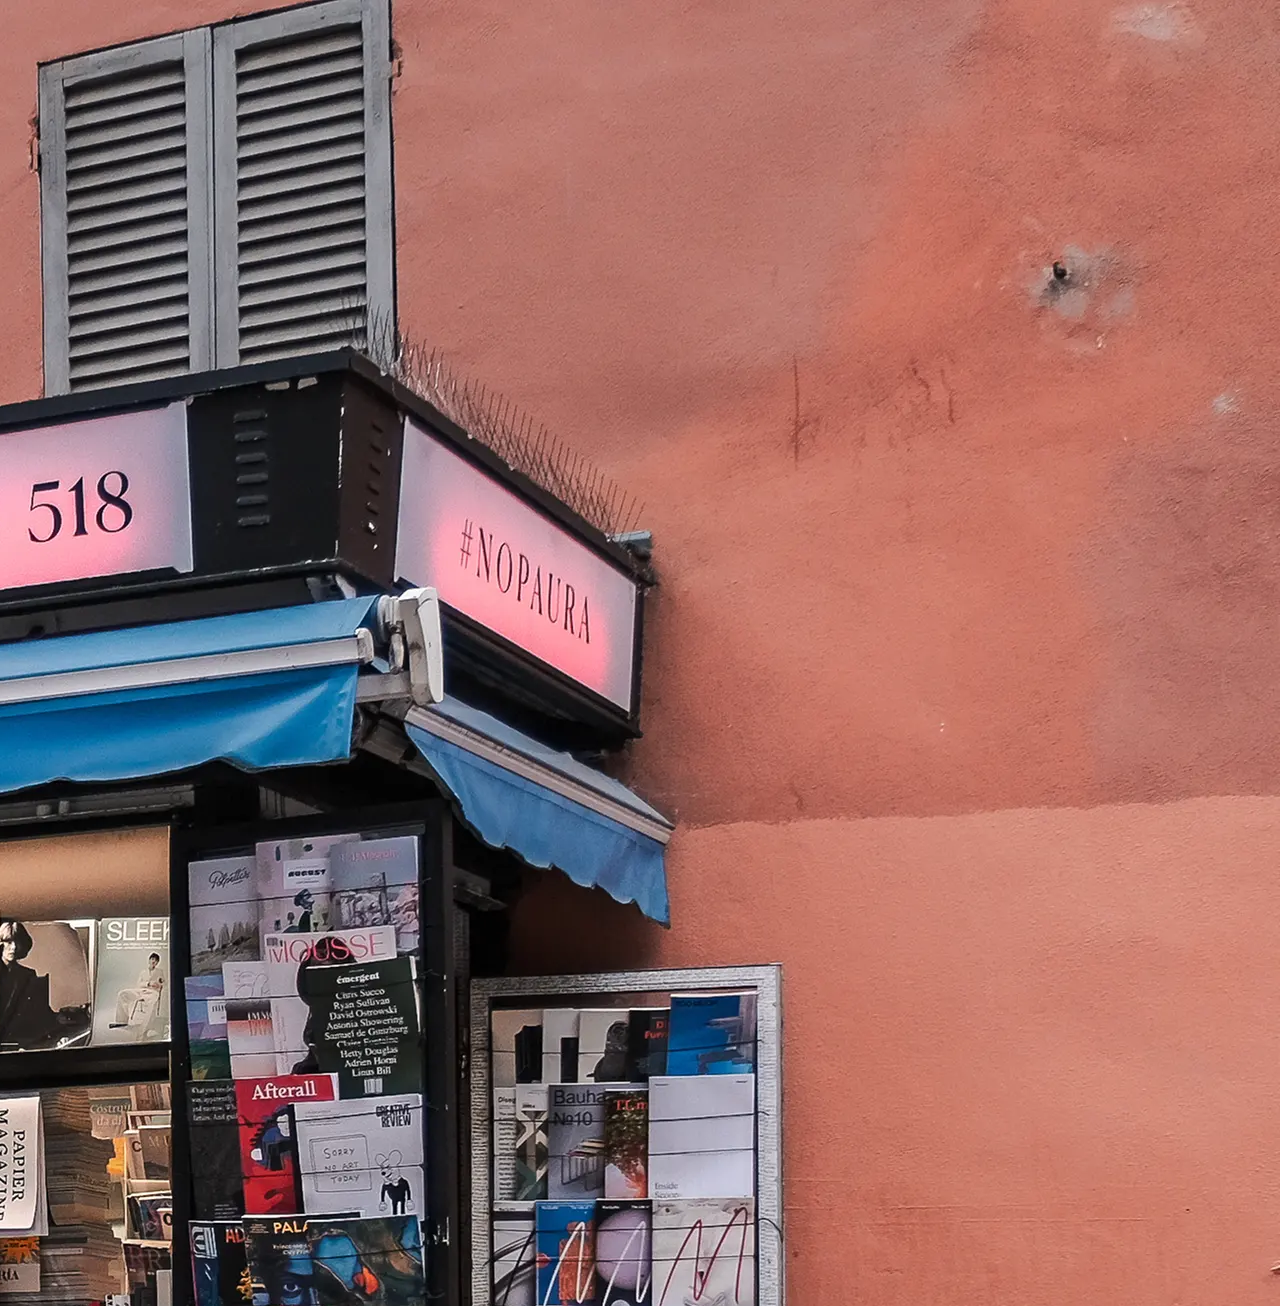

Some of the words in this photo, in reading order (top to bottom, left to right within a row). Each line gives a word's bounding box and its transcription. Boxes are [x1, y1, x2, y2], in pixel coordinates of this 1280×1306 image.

[27, 469, 135, 544] 518
[459, 517, 591, 645] #NOPAURA
[269, 931, 387, 964] MOUSSE
[336, 972, 380, 984] émergent
[333, 1001, 355, 1012] Ryan
[329, 1010, 355, 1021] David
[364, 1046, 399, 1057] Douglas
[376, 1066, 392, 1076] Bill
[251, 1080, 318, 1101] Afterall
[381, 1113, 412, 1128] REVIEW
[11, 1129, 26, 1203] PAPIER
[330, 1174, 360, 1184] TODAY
